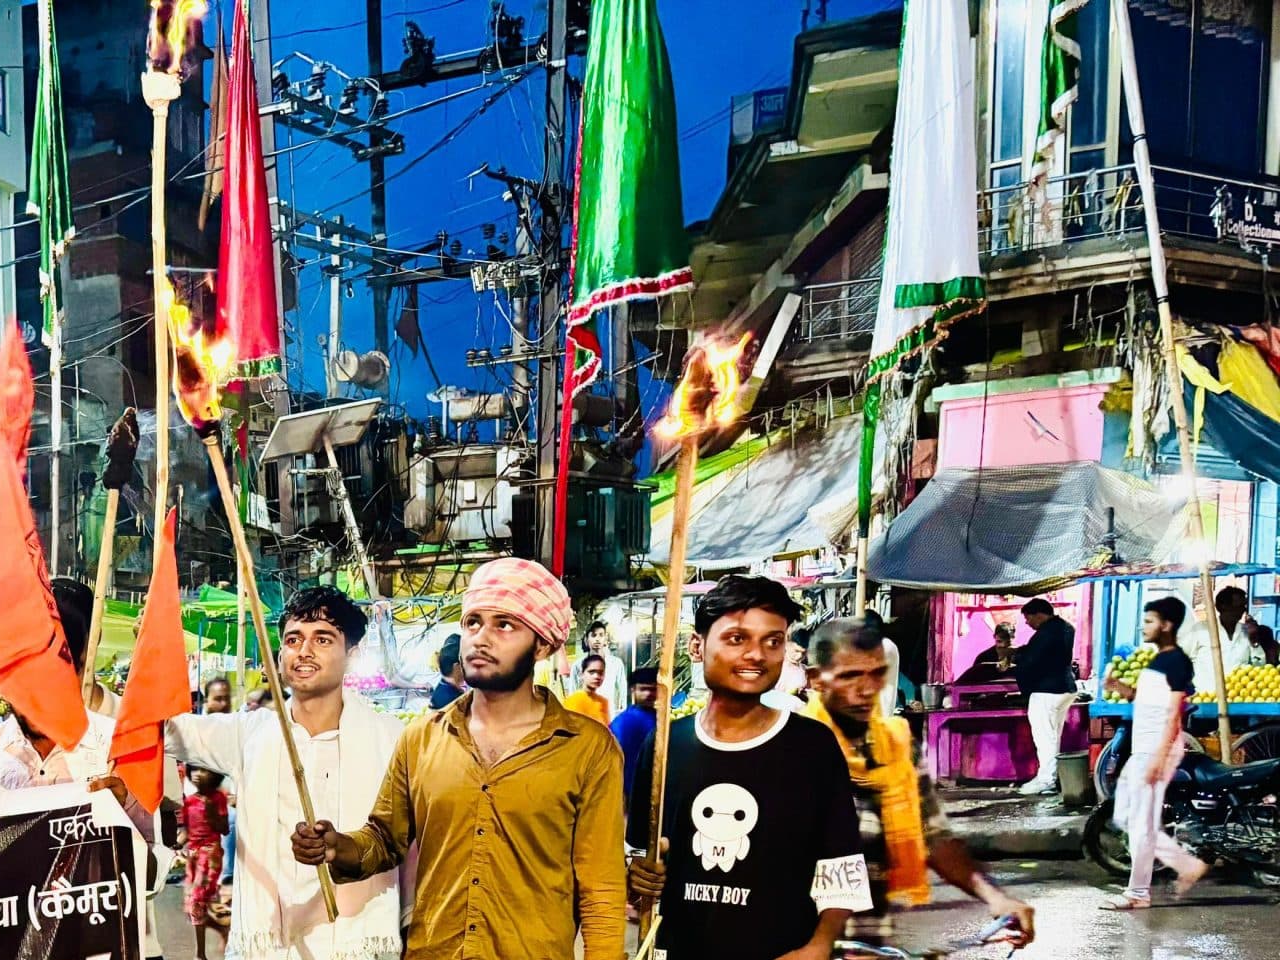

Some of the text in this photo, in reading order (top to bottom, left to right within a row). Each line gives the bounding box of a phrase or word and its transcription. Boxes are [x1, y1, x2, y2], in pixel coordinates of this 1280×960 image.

[712, 846, 725, 857] M
[684, 883, 750, 906] NICKY BOY
